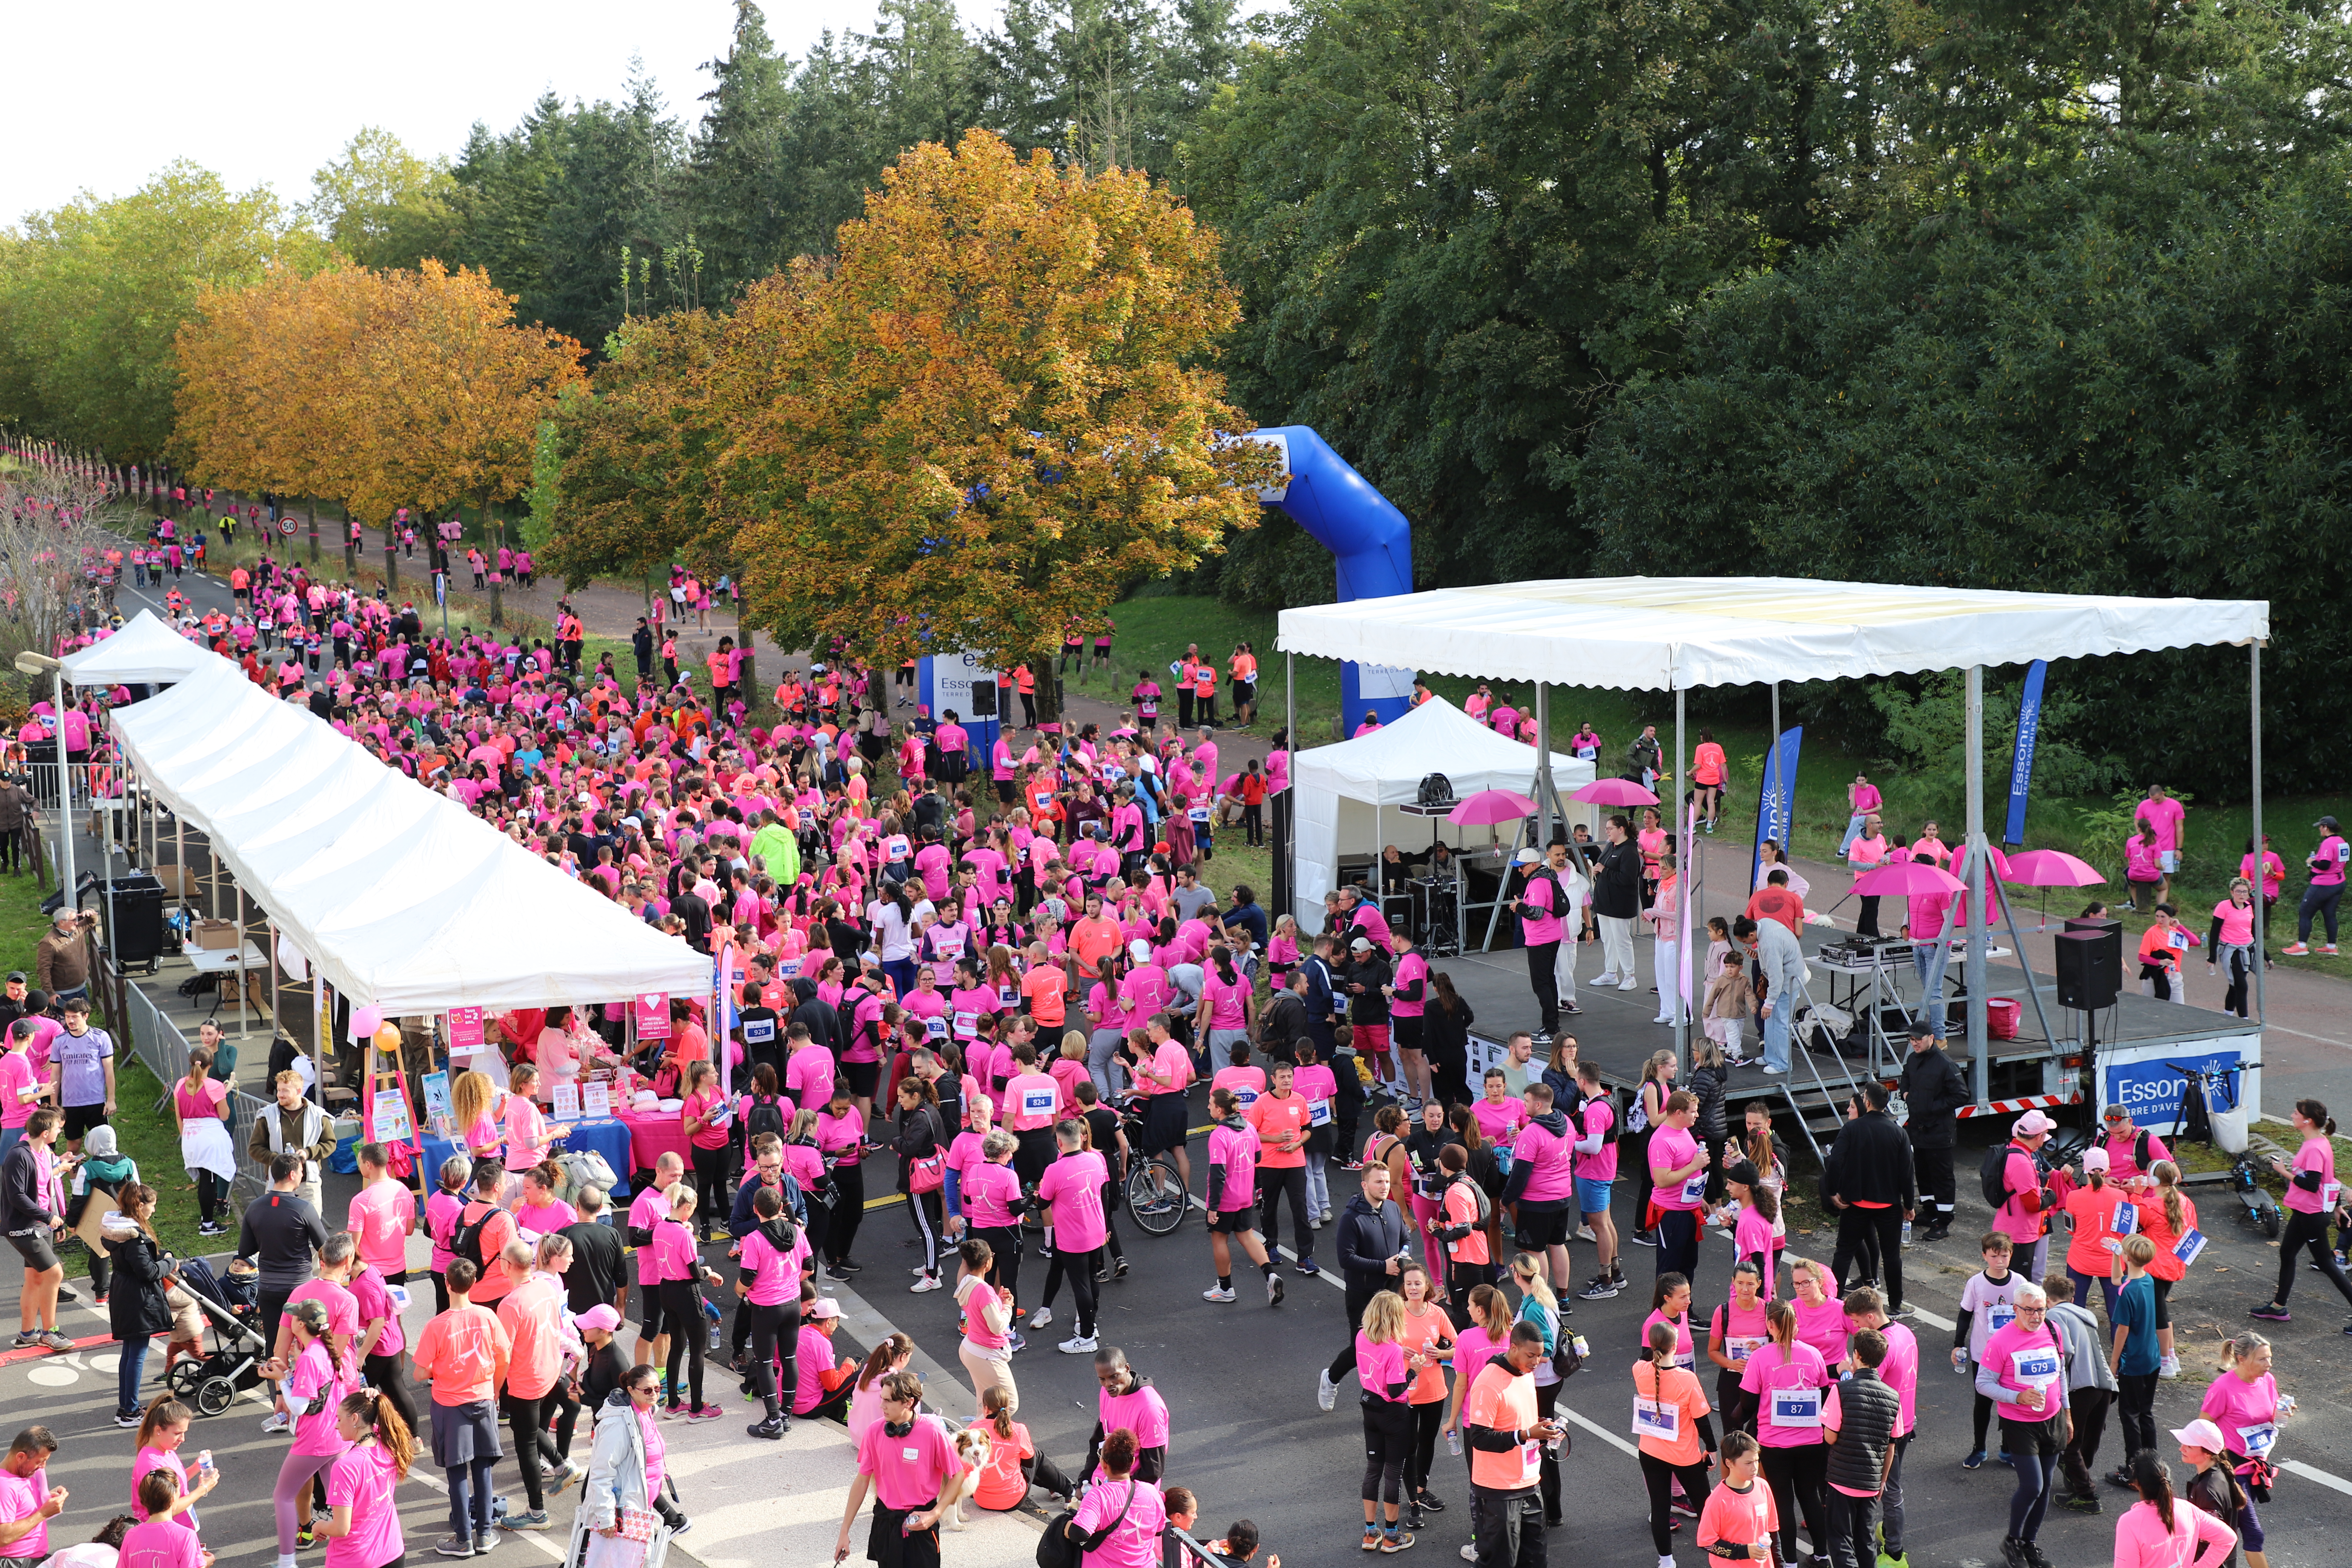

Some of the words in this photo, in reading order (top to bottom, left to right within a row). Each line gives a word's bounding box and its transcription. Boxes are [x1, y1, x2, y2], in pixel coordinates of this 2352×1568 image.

[2026, 721, 2036, 767] D'AVENIRS
[2118, 1073, 2219, 1105] Essone
[1311, 1110, 1321, 1119] 934
[2121, 1209, 2132, 1225] 766
[2183, 1238, 2196, 1254] 767
[2031, 1362, 2048, 1373] 679
[1791, 1405, 1803, 1413] 87
[1650, 1414, 1661, 1425] 82
